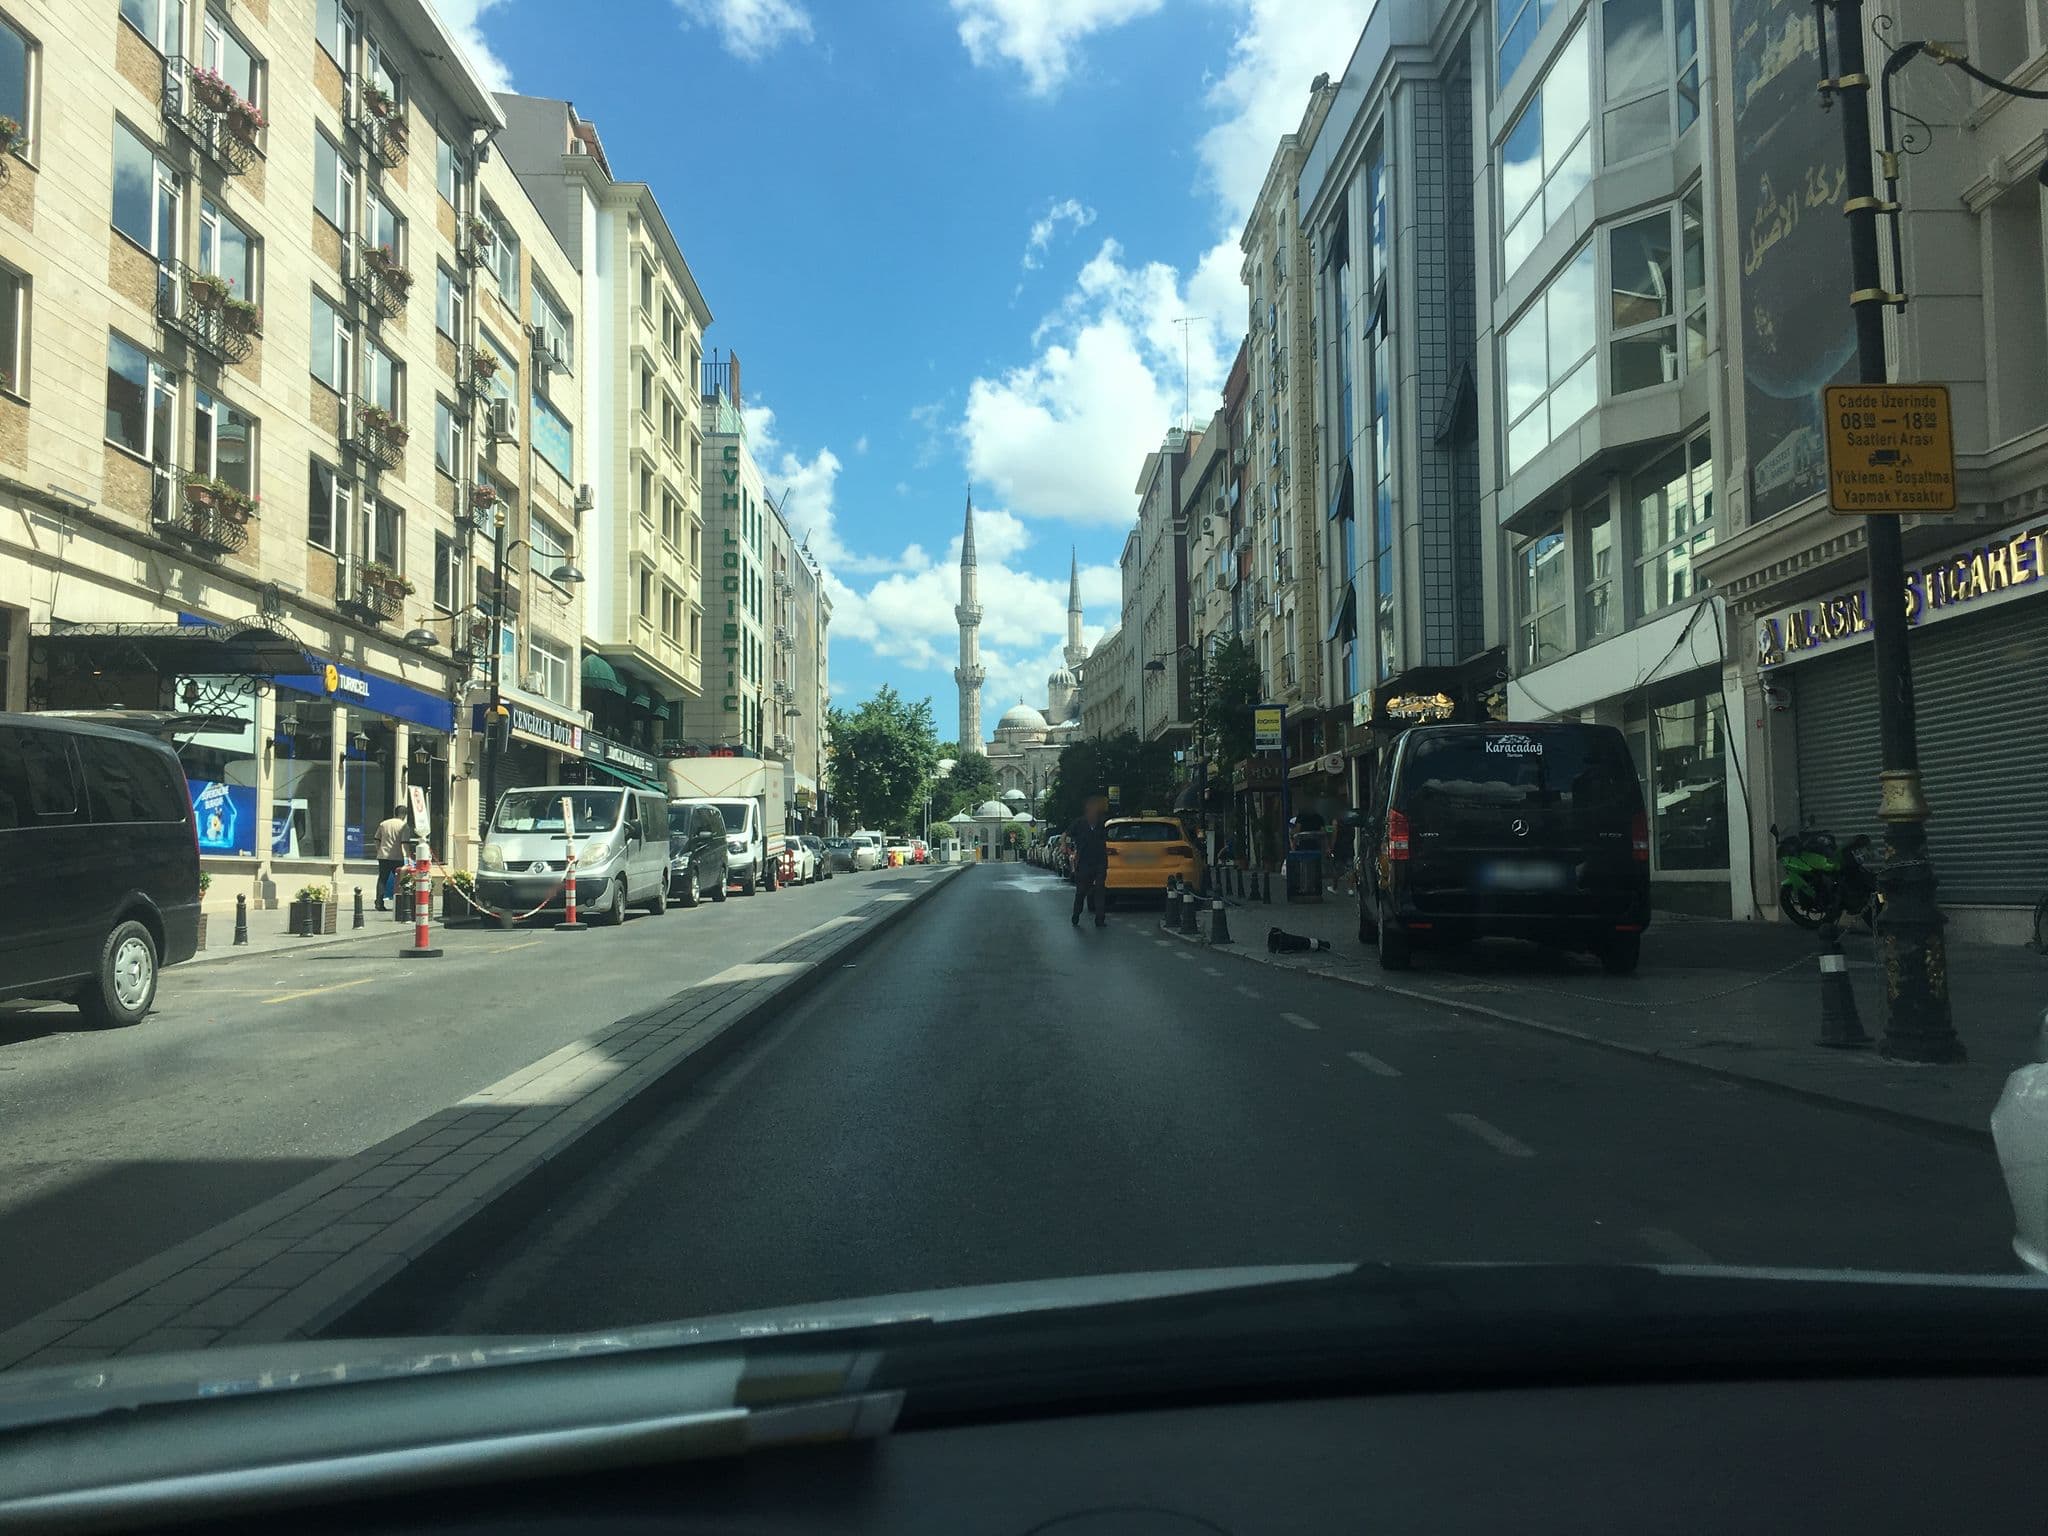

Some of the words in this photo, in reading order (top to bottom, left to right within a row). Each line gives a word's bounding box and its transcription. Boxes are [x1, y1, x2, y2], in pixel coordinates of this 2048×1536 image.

[1838, 394, 1878, 409] Cadde
[1881, 392, 1937, 409] Üzerinde
[1847, 432, 1896, 447] Saatleri
[1899, 432, 1934, 447] Arası
[1835, 469, 1885, 485] Yükleme
[1895, 469, 1950, 485] Boşaltma
[1843, 489, 1893, 504] Yapmak
[1894, 489, 1944, 505] Yasaktır
[723, 528, 739, 711] LOGISTIC
[339, 674, 370, 697] TURKCELL
[1485, 741, 1543, 756] Karacadağ
